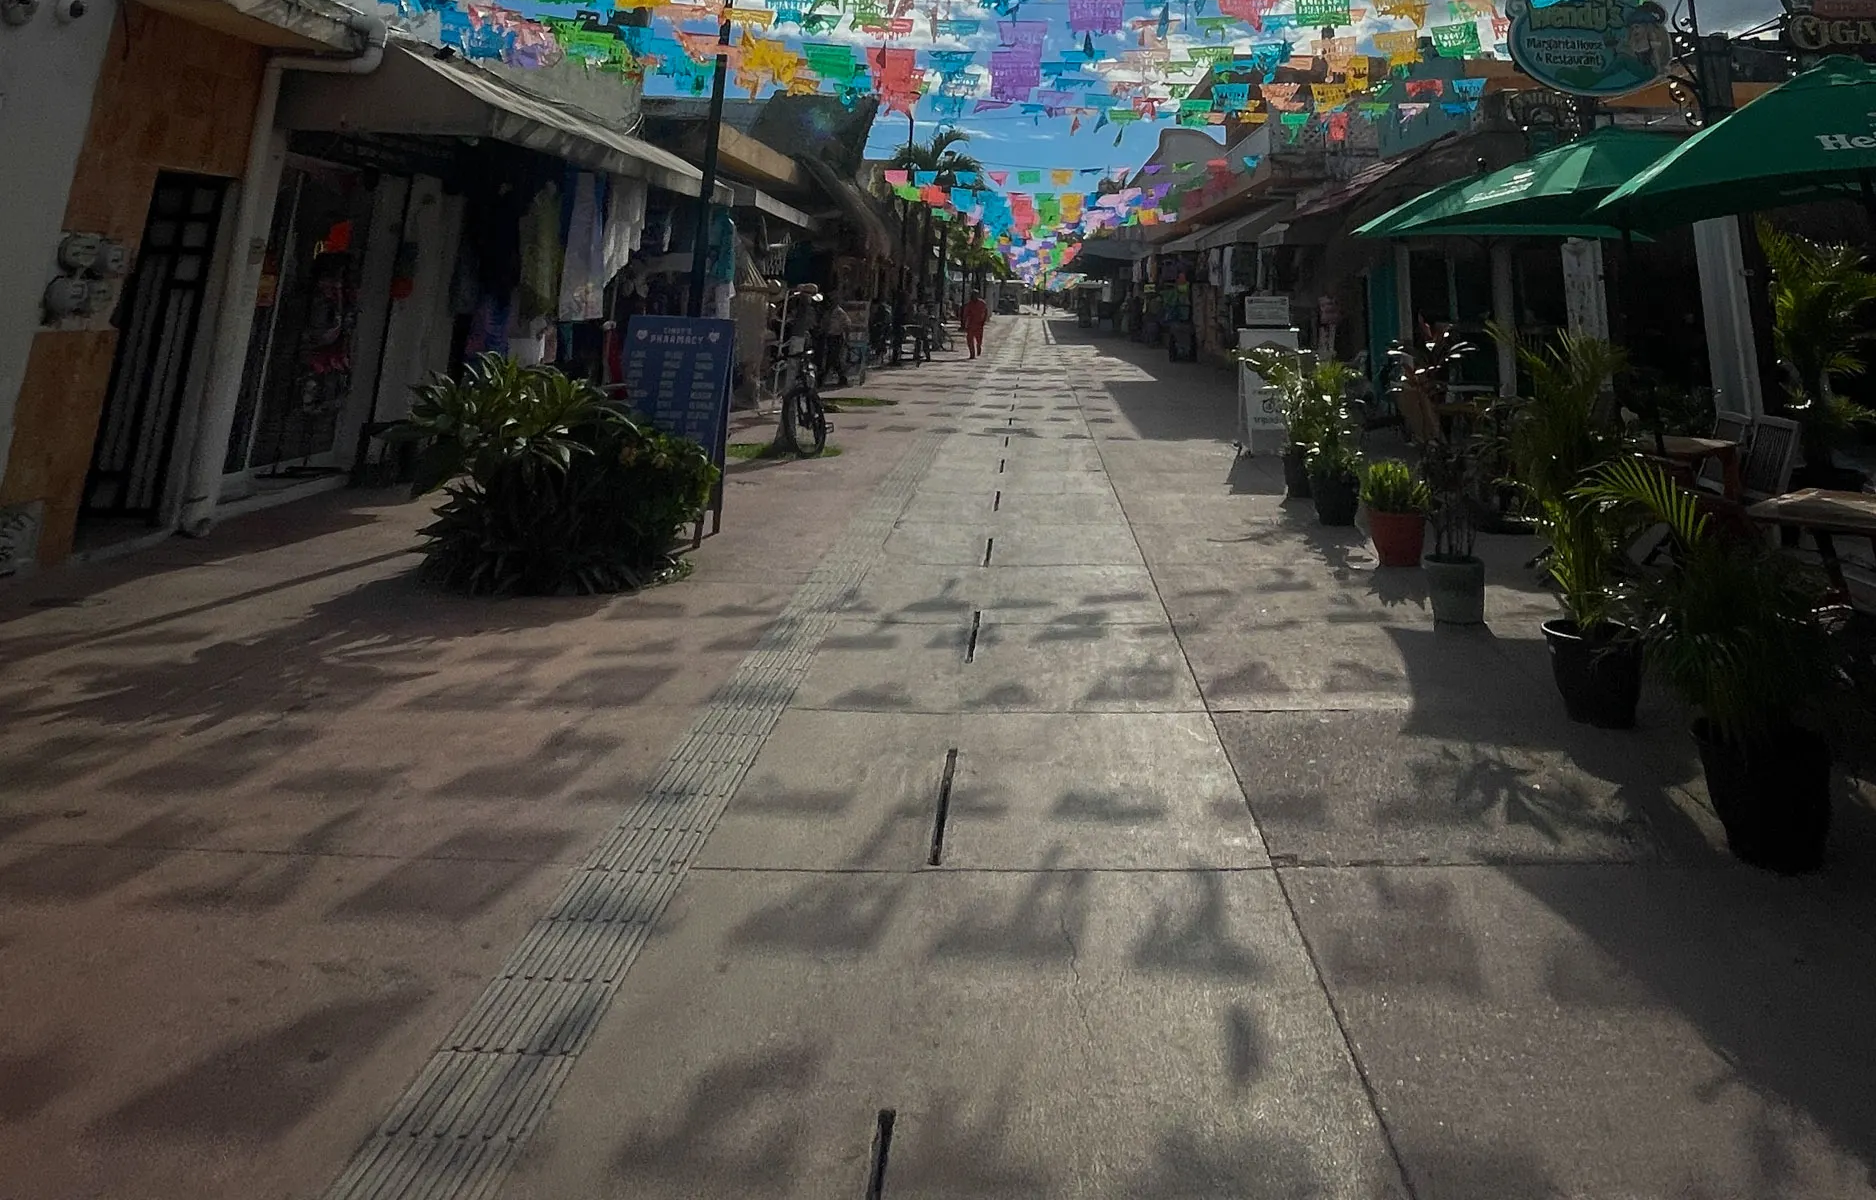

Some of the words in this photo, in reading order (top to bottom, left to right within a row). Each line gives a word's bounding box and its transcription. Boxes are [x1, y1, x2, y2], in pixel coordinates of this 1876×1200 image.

[1530, 0, 1624, 32] Wendy's
[1526, 36, 1576, 50] Margarita
[1577, 39, 1603, 50] House
[1545, 53, 1601, 65] Restaurant
[650, 335, 704, 344] PHARMACY
